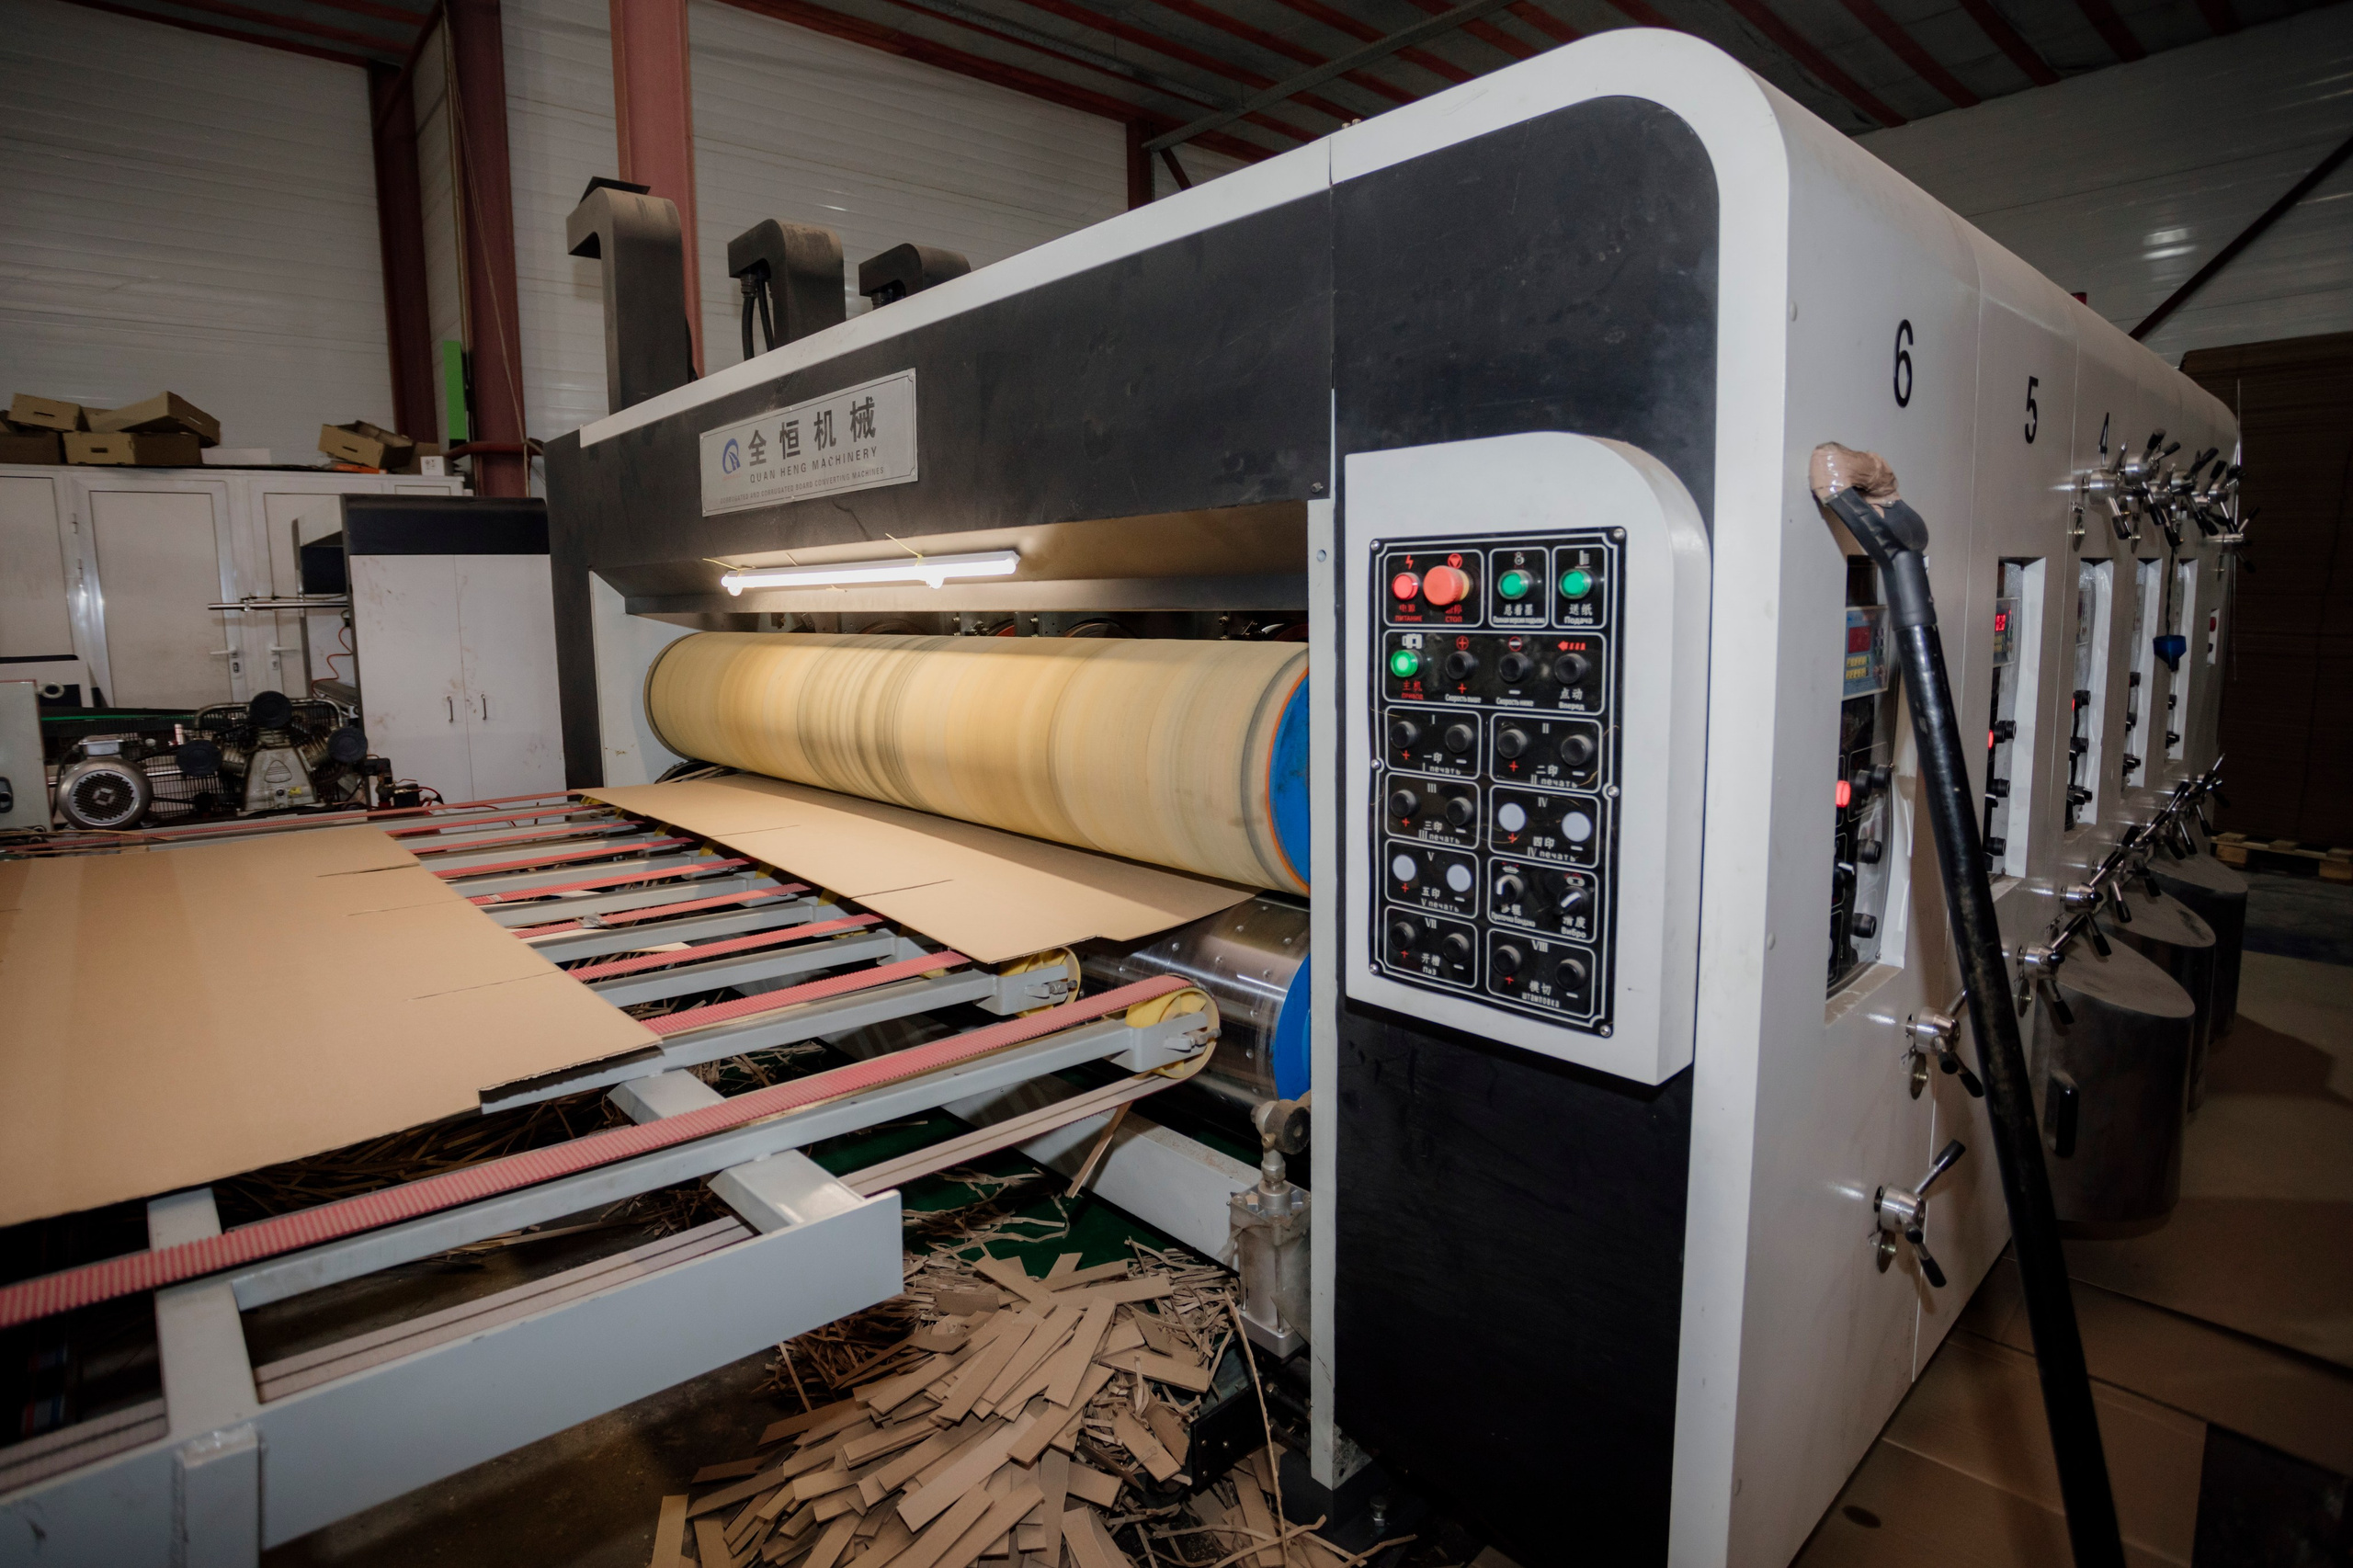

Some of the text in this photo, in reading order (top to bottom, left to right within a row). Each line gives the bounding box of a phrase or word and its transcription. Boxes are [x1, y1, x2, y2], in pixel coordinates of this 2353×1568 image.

[1893, 319, 1914, 408] 6
[2025, 376, 2039, 444] 5
[747, 396, 877, 467] 全恒机械
[750, 470, 776, 483] QUAN
[779, 462, 807, 478] HENG
[812, 446, 878, 472] MACHINERY
[750, 490, 760, 499] AND
[761, 485, 794, 498] CORRUGATED
[795, 480, 813, 492] BOARD
[814, 472, 850, 487] CONVERTING
[851, 466, 884, 480] MACHINES
[1569, 603, 1594, 616] 送纸
[1445, 615, 1462, 623] СТОП
[1563, 616, 1594, 626] Подача
[1560, 687, 1584, 700] 点动
[1429, 766, 1461, 776] печать
[1535, 764, 1558, 777] 二印
[1540, 778, 1578, 789] печать
[1538, 797, 1548, 808] IV
[1423, 821, 1443, 833] 三印
[1429, 834, 1461, 845] печать
[1533, 836, 1555, 849] 四印
[1427, 851, 1435, 861] V
[1539, 850, 1576, 862] печать
[1421, 886, 1440, 899] 五印
[1428, 901, 1460, 913] печать
[1561, 926, 1587, 938] Вибро
